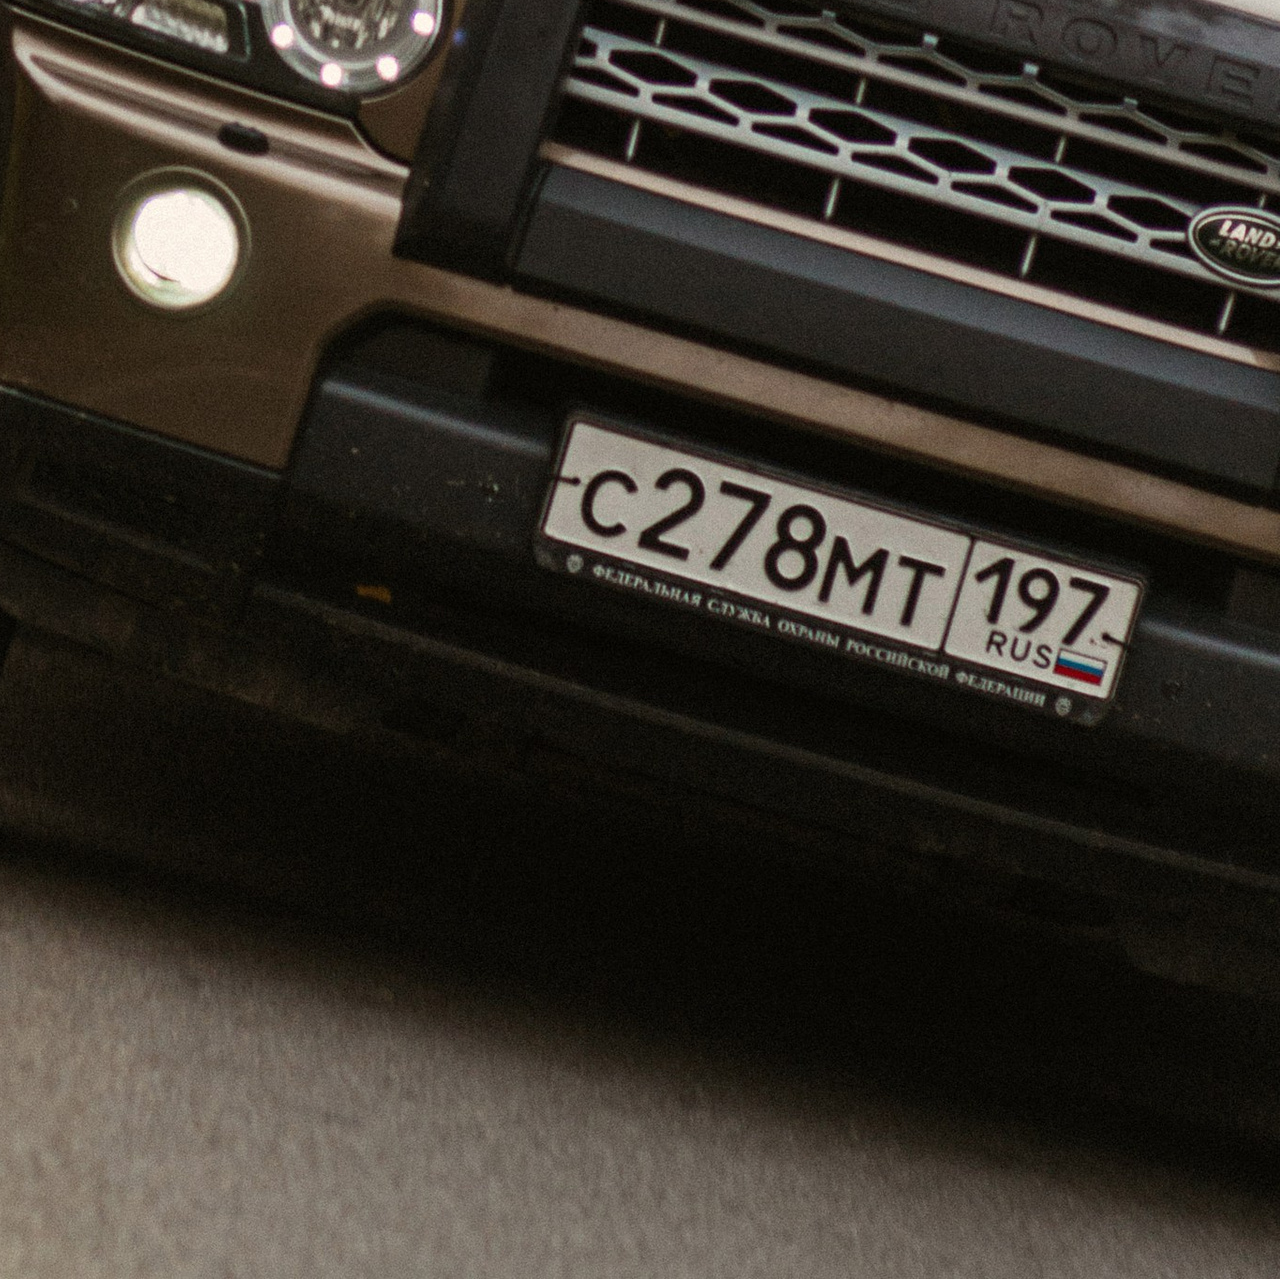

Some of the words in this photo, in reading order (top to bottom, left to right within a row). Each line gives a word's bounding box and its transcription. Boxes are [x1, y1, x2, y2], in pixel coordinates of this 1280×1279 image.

[592, 564, 702, 607] ФЕДЕРАЛЬНАЯ
[707, 598, 770, 628] СЛУЖБА
[777, 618, 839, 648] ОХРАНЫ
[845, 639, 950, 680] РОССИЙСКОЙ
[956, 670, 1046, 707] ФЕДЕРАЦИИ
[974, 557, 1110, 646] 197
[985, 630, 1053, 670] RUS
